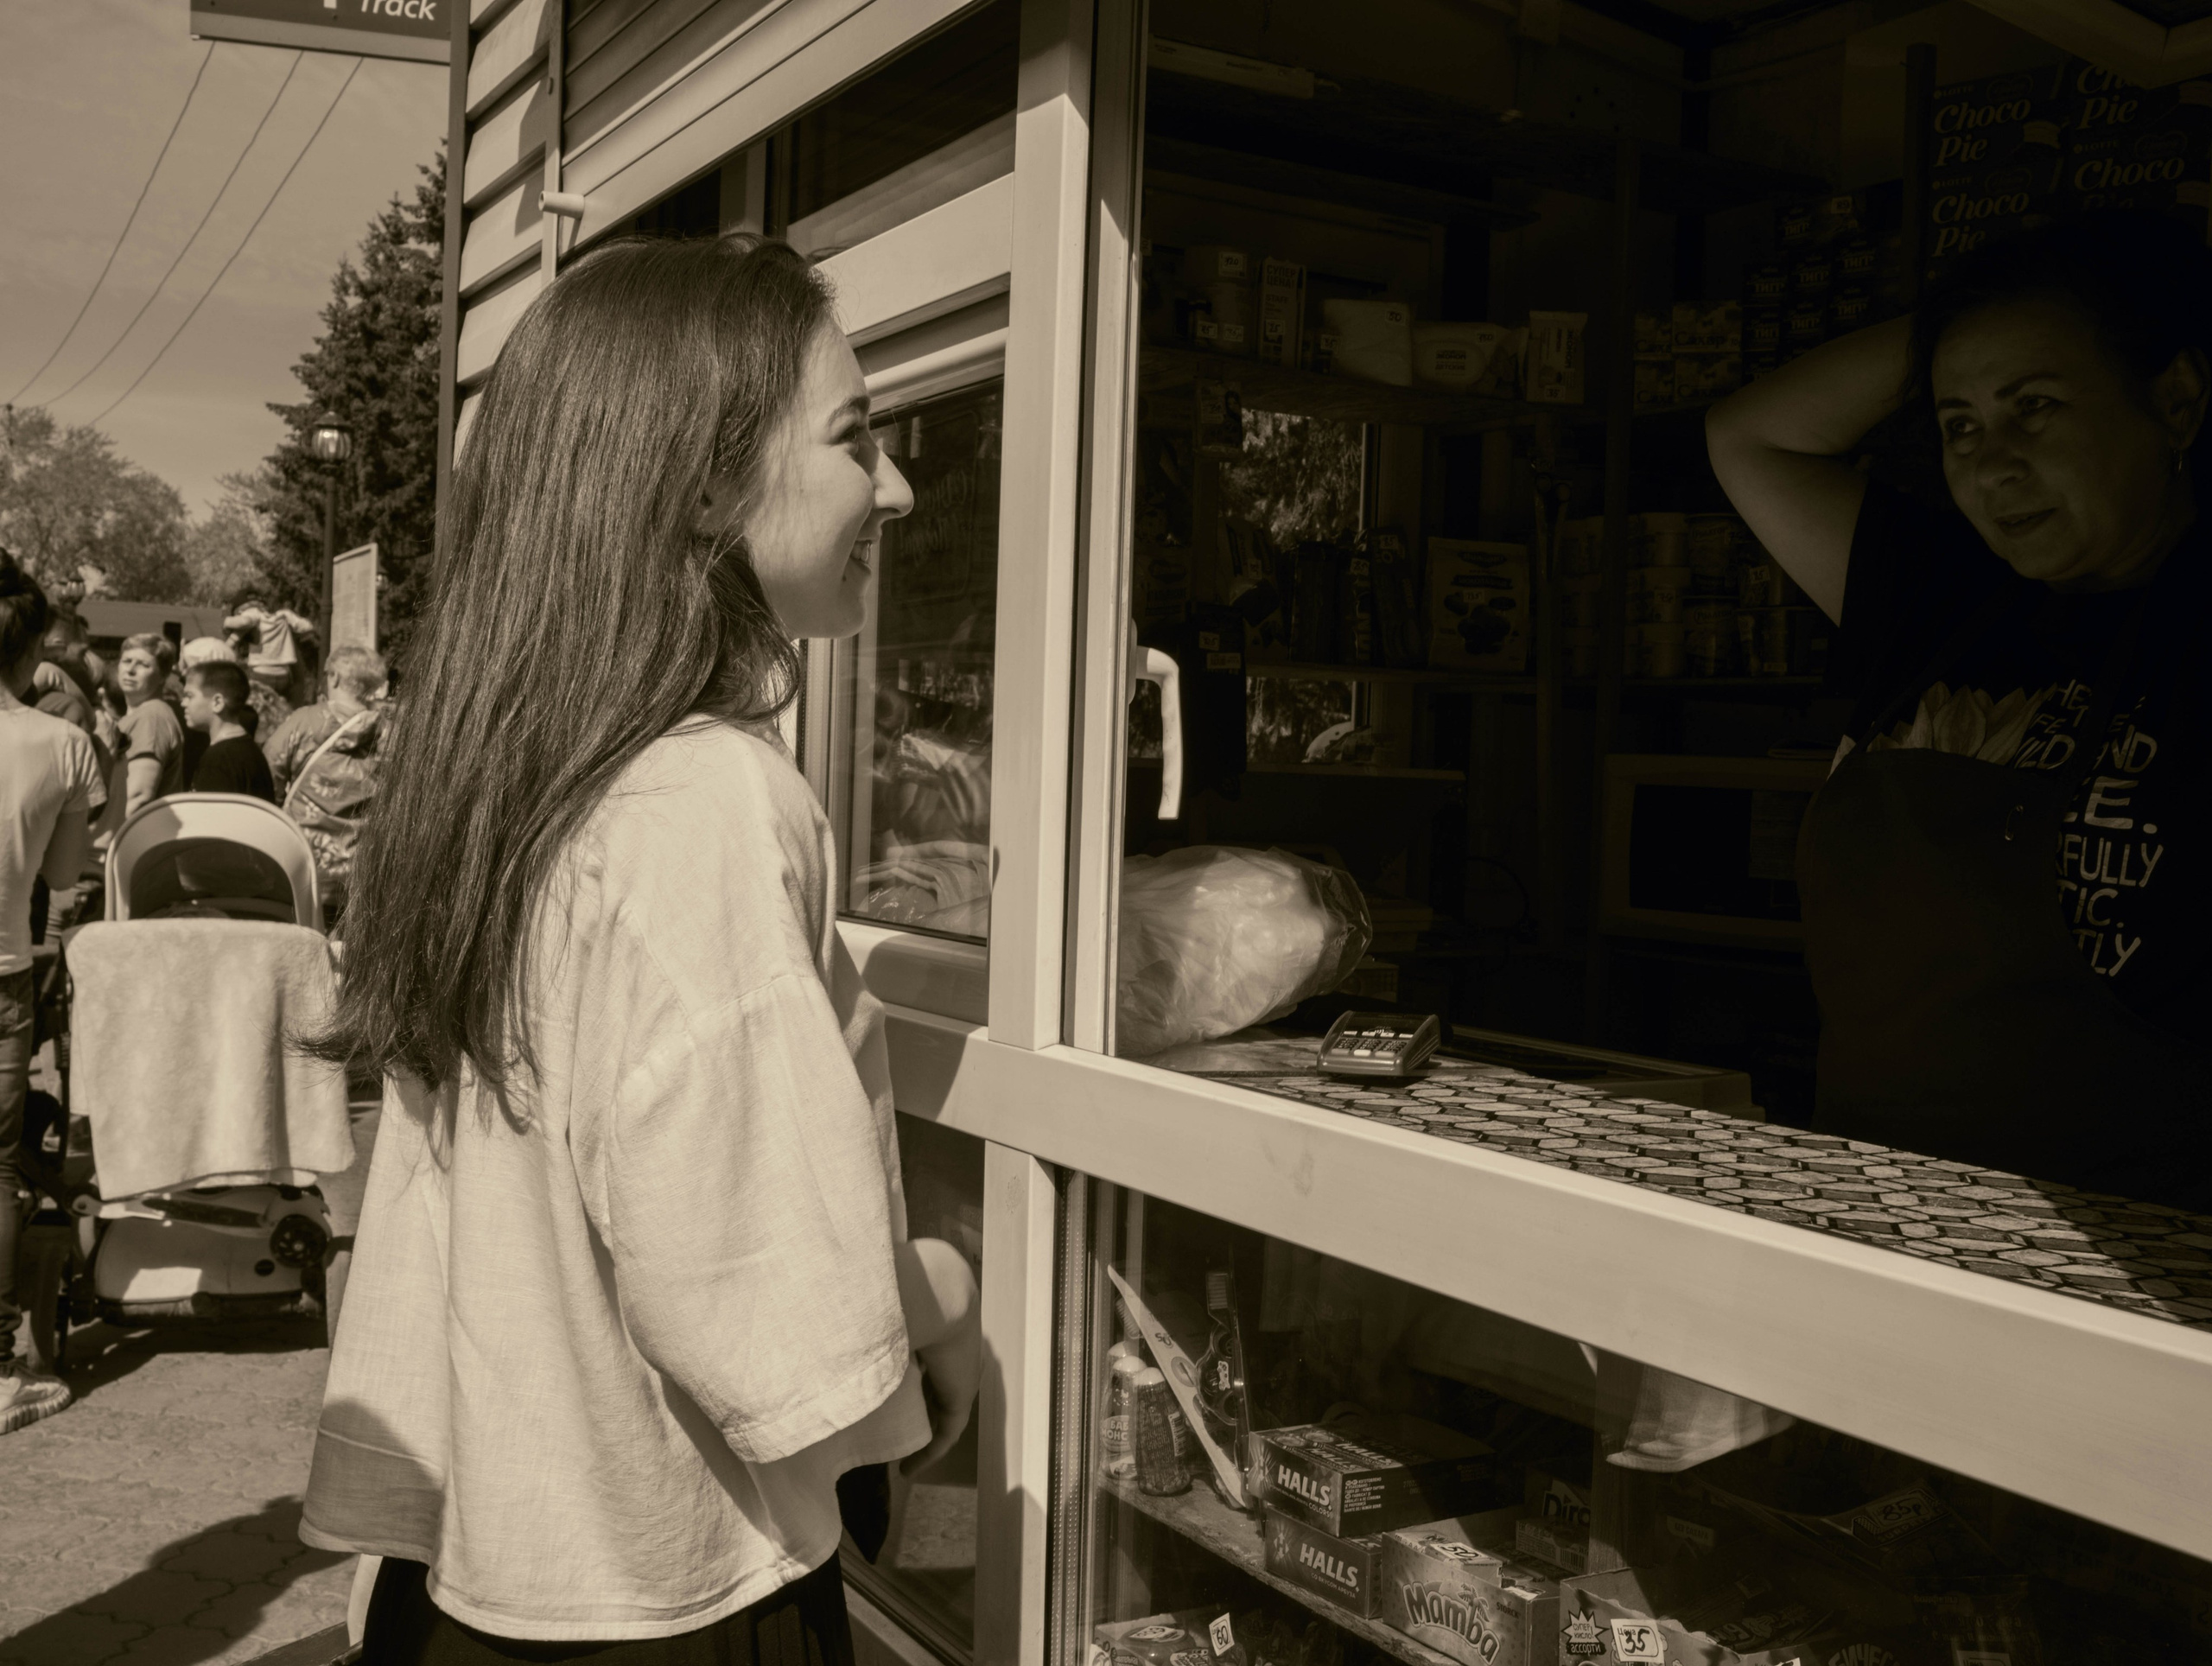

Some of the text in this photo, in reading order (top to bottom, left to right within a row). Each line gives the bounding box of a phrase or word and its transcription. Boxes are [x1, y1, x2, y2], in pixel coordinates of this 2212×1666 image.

[1934, 99, 2031, 135] Choco
[2076, 95, 2139, 130] Pie
[1933, 134, 1988, 168] Pie
[2074, 157, 2185, 192] Choco
[1932, 193, 2031, 225] Choco
[1931, 226, 1986, 258] Pie
[1266, 264, 1296, 277] СУПЕР
[1675, 331, 1726, 348] Сахар
[1278, 1464, 1332, 1507] HALLS
[1543, 1491, 1591, 1527] Diro
[1300, 1542, 1359, 1588] HALLS
[1402, 1582, 1500, 1665] Mamba
[1573, 1623, 1591, 1631] СУПЕР
[1570, 1644, 1602, 1656] ассорти
[1624, 1628, 1650, 1654] 35
